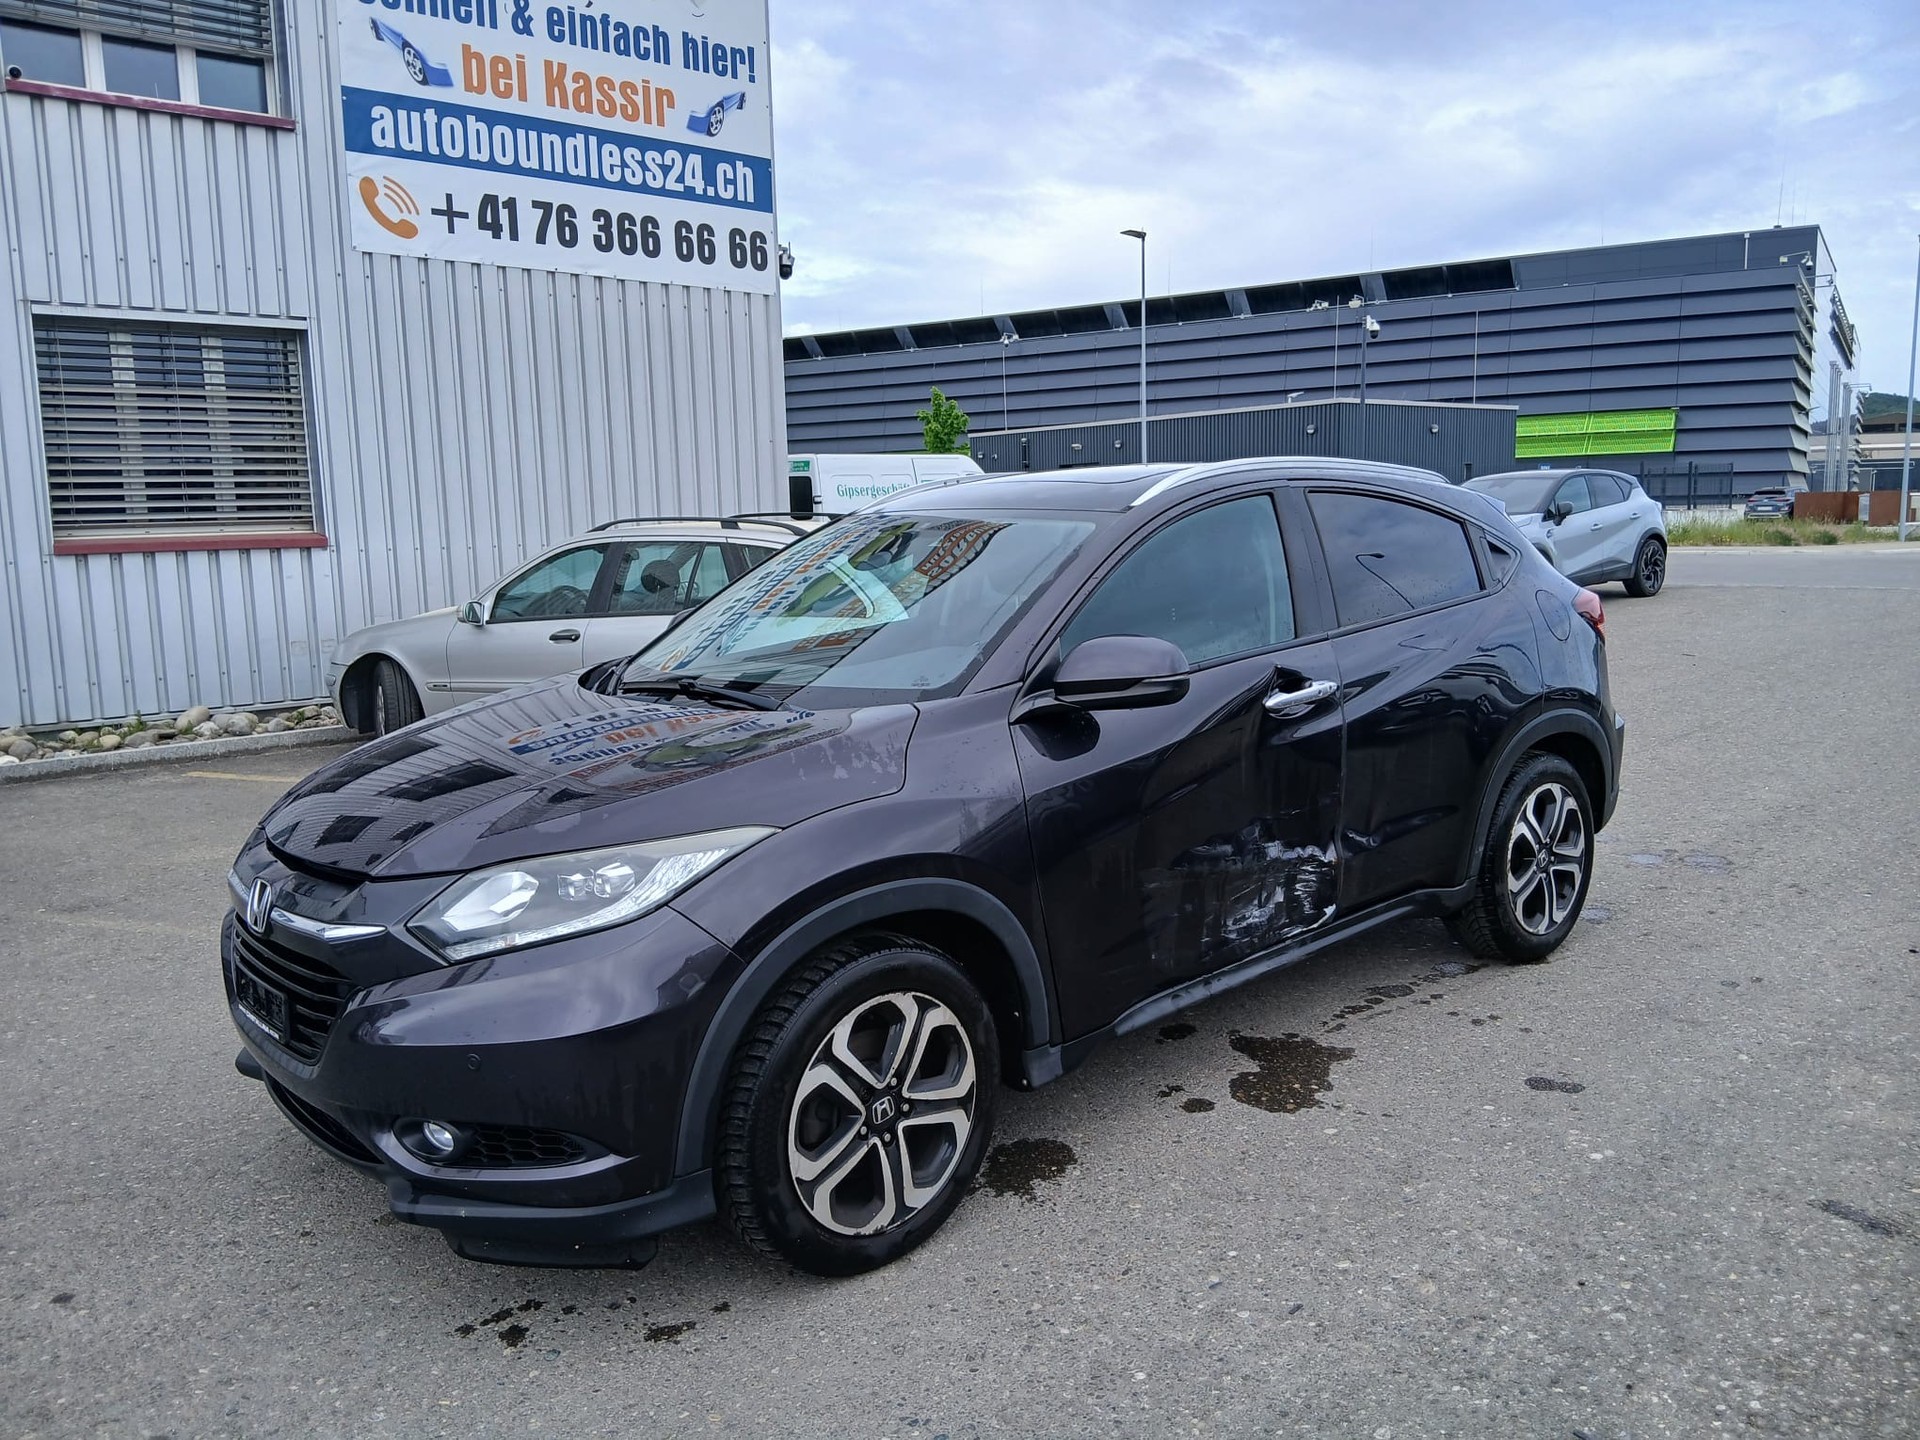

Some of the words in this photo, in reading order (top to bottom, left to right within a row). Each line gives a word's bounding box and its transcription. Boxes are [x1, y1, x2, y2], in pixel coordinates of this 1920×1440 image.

[511, 0, 534, 37] &
[547, 5, 671, 65] einfach
[682, 31, 756, 84] hier!
[462, 43, 527, 102] bei
[544, 59, 675, 128] Kassir
[371, 104, 755, 203] autoboundless24.ch
[532, 199, 579, 249] 76
[592, 208, 661, 259] 366
[675, 218, 716, 266] 66
[729, 227, 769, 272] 66
